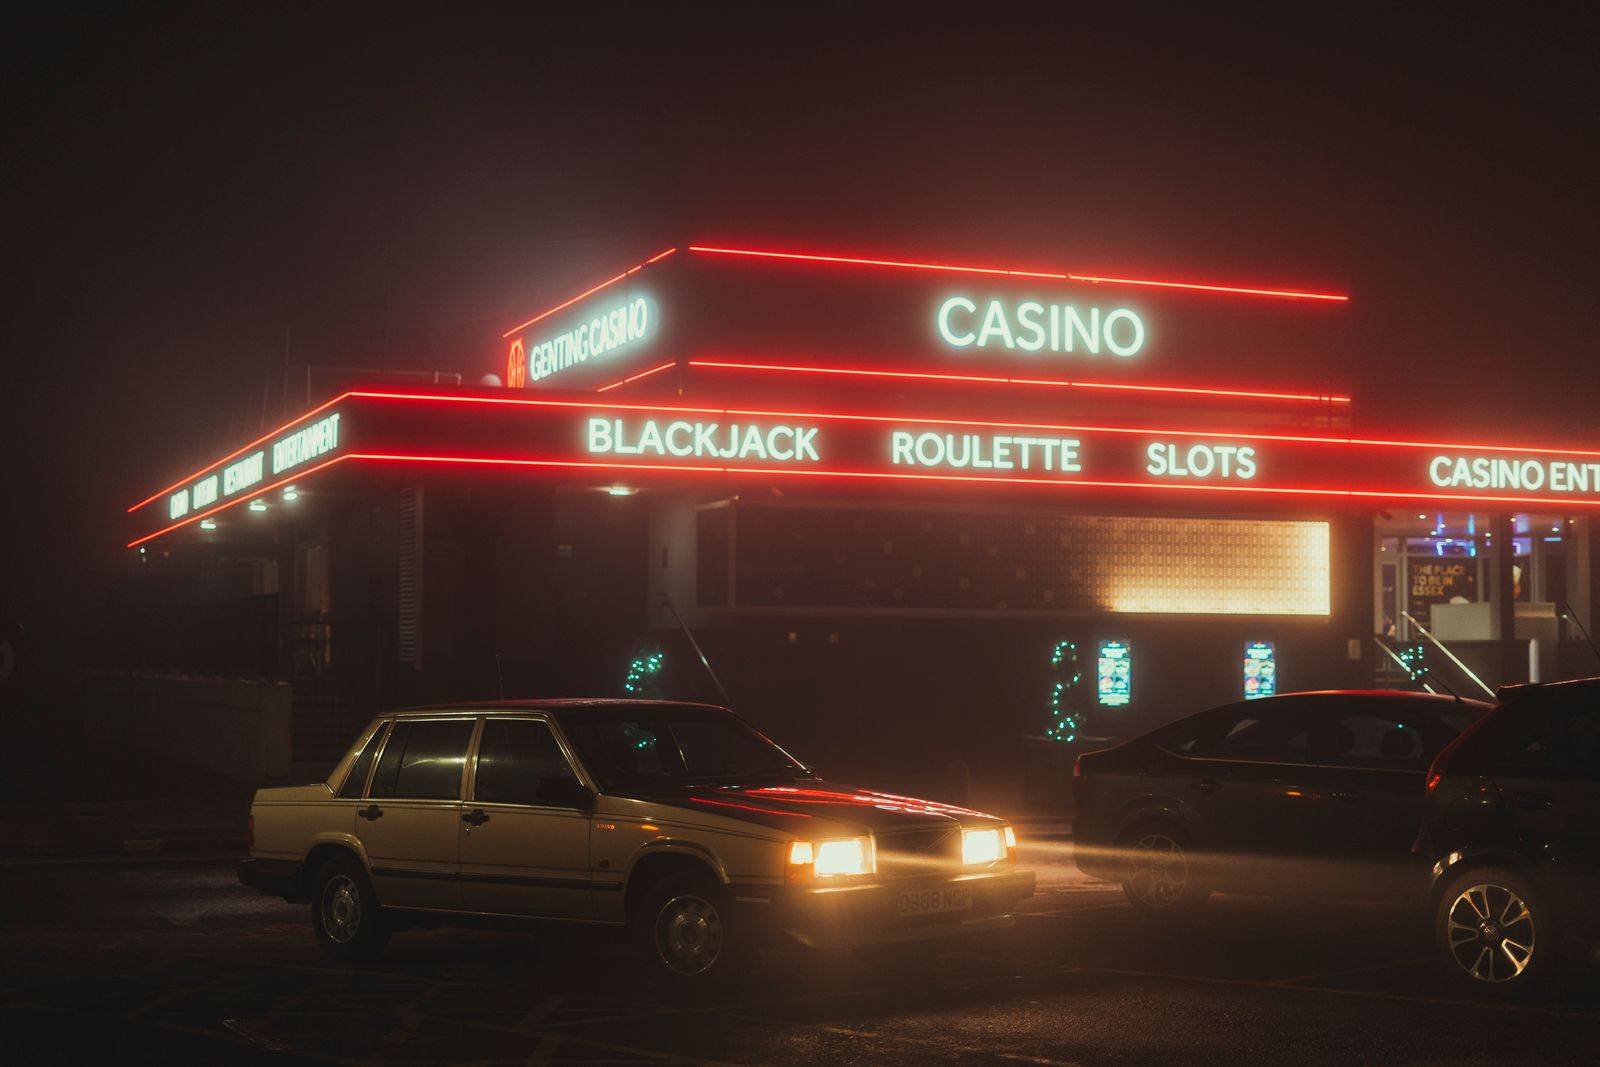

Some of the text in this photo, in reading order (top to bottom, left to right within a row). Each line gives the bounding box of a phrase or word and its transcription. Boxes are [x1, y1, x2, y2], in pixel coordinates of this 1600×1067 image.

[529, 298, 648, 382] GENTING CASINO
[937, 296, 1145, 357] CASINO
[587, 417, 821, 462] BLACKJACK
[891, 431, 1082, 473] ROULETTE
[1146, 442, 1257, 480] SLOTS
[1429, 456, 1600, 492] CASINO ENT
[1412, 564, 1465, 576] THE PLACE
[1412, 575, 1427, 586] TO
[1412, 585, 1445, 596] ESSEX
